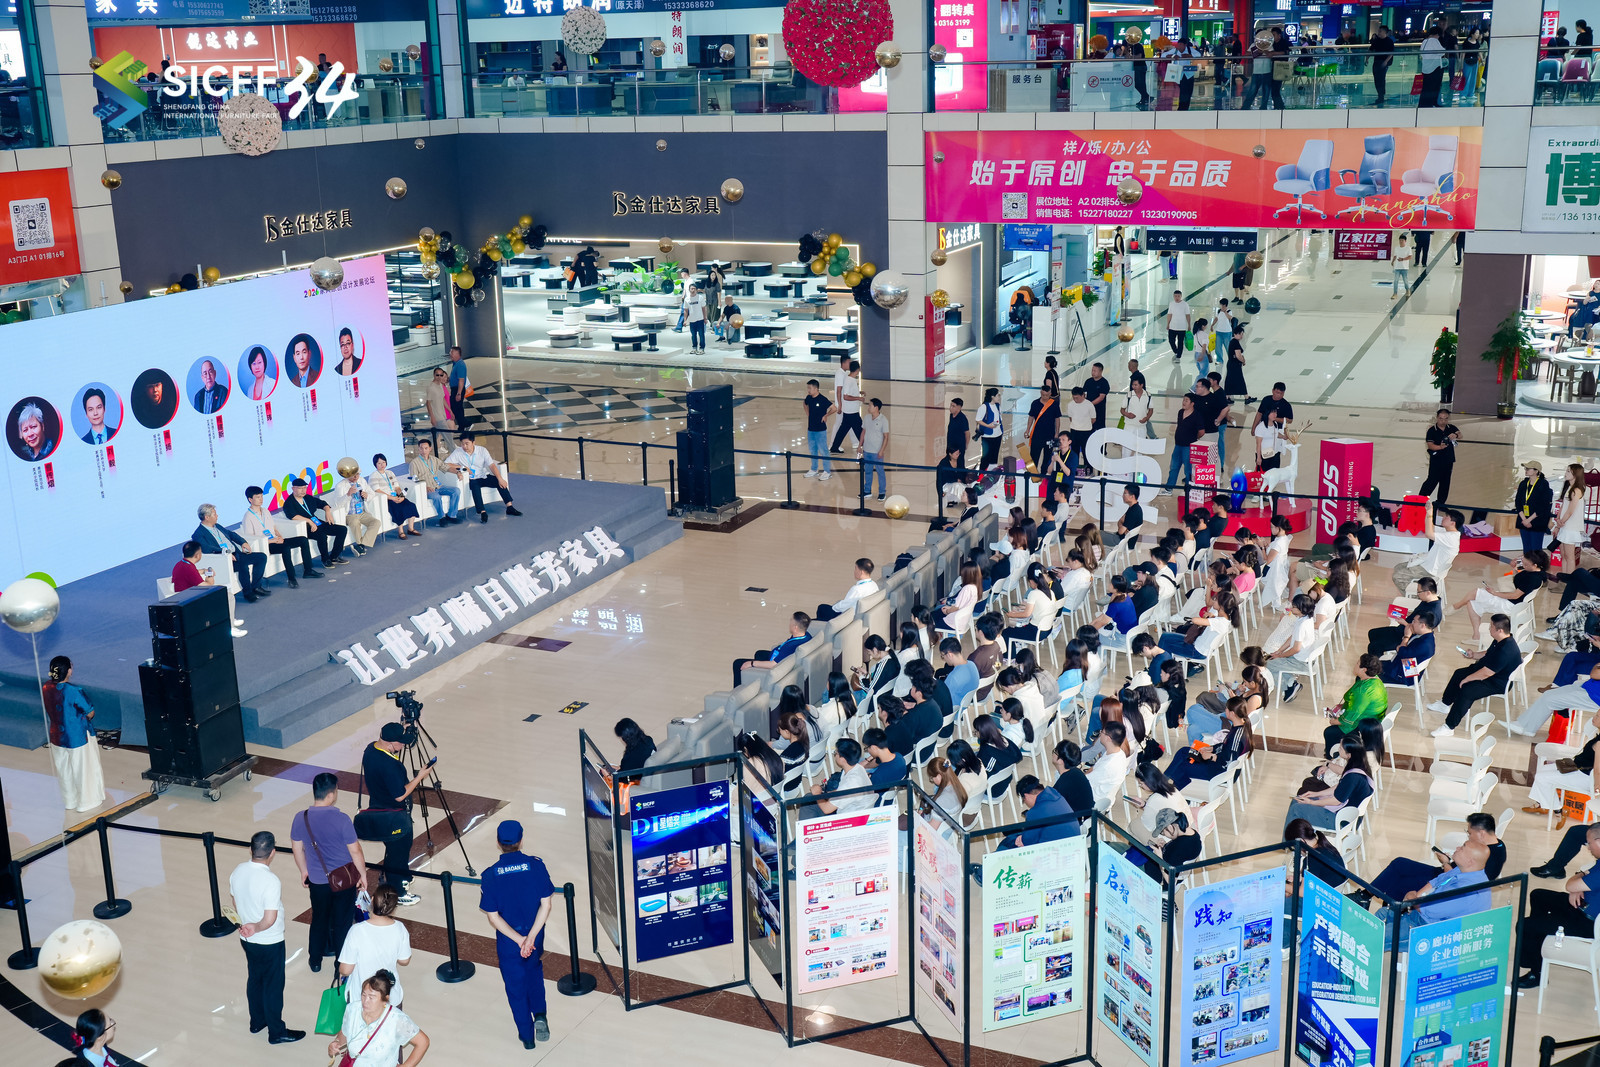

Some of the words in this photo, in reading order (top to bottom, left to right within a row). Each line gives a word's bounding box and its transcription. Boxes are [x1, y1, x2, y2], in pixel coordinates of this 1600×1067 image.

[663, 1, 715, 10] 15333368620
[940, 4, 975, 17] 翻转桌
[312, 14, 358, 23] 15333368620
[955, 18, 971, 26] 3199
[1012, 74, 1042, 84] 服务台
[969, 160, 1086, 186] 始于原创
[1106, 160, 1232, 188] 忠于品质
[1545, 152, 1600, 206] 博
[630, 194, 721, 215] 金仕达家具
[1078, 198, 1090, 206] A2
[1078, 210, 1133, 218] 15227180227
[1141, 210, 1197, 219] 13230190905
[280, 208, 353, 238] 金仕达家具
[946, 223, 981, 249] 金仕达家具
[1338, 233, 1388, 243] 亿家亿客
[8, 255, 28, 265] A3门口
[29, 254, 38, 262] A1
[1321, 459, 1339, 537] SFUP
[337, 525, 625, 686] 让世界瞩目胜芳家具
[993, 865, 1033, 890] 传薪
[1104, 864, 1130, 904] 启智
[1194, 903, 1233, 929] 践知
[1313, 913, 1371, 967] 产教融合
[1432, 923, 1495, 948] 廊坊师范学院
[1430, 938, 1493, 962] 企业创新服务
[1312, 935, 1369, 991] 示范基地
